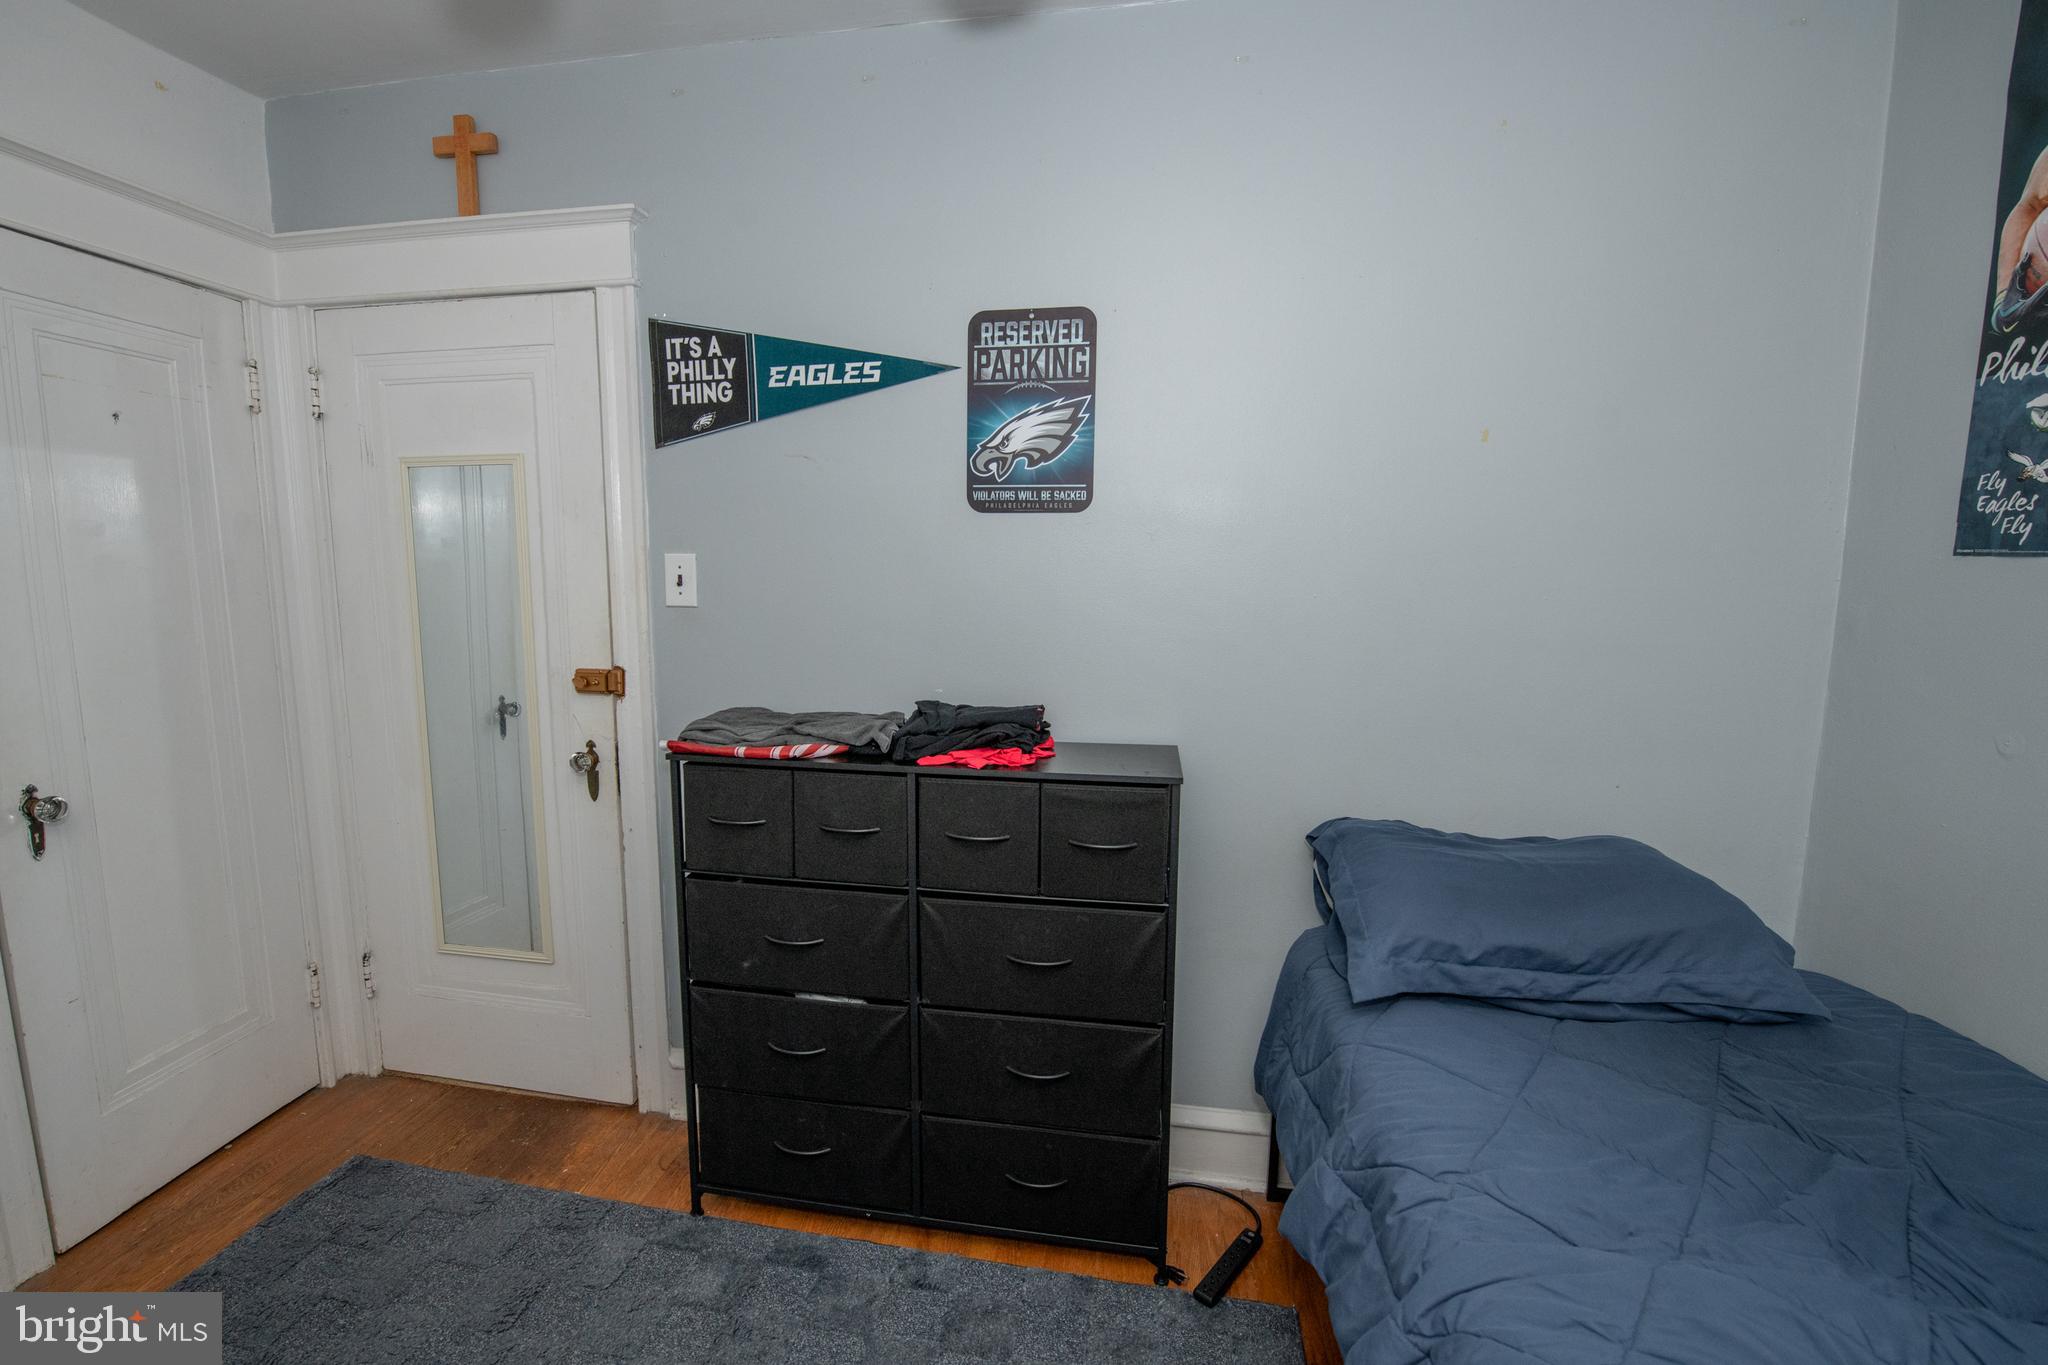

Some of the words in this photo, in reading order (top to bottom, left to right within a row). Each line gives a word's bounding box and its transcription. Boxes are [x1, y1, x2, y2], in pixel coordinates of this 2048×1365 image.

[980, 319, 1084, 346] RESERVED
[665, 336, 702, 360] IT'S
[707, 335, 723, 358] A
[1979, 335, 2048, 387] Phil
[666, 357, 737, 383] PHILLY
[768, 360, 882, 388] EAGLES
[975, 346, 1090, 381] PARKING
[667, 381, 734, 406] THING
[972, 490, 1016, 501] VIOLATORS
[1017, 490, 1039, 501] WILL
[1040, 490, 1052, 501] BE
[1053, 489, 1087, 501] SACKED
[1976, 470, 2008, 497] Fly
[1976, 491, 2039, 526] Eagles
[2000, 514, 2033, 546] Fly
